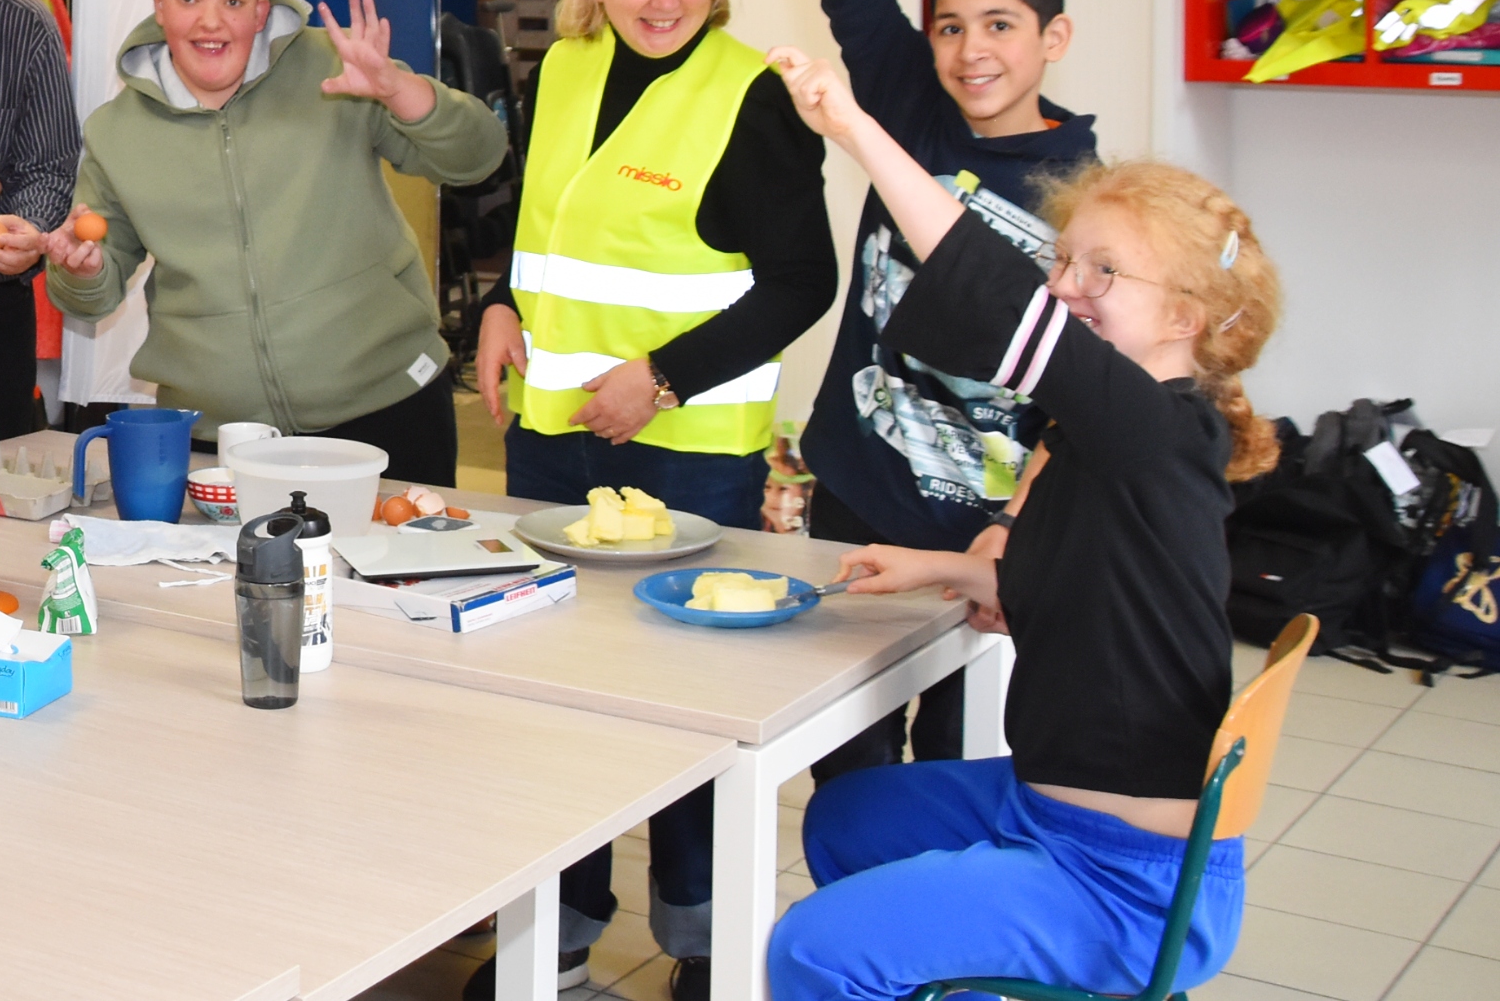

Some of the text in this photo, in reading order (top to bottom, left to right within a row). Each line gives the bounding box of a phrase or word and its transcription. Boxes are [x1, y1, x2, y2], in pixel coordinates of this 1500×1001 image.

[618, 165, 682, 191] missio
[929, 479, 977, 501] RIDES
[506, 586, 537, 602] LEIFHEIT
